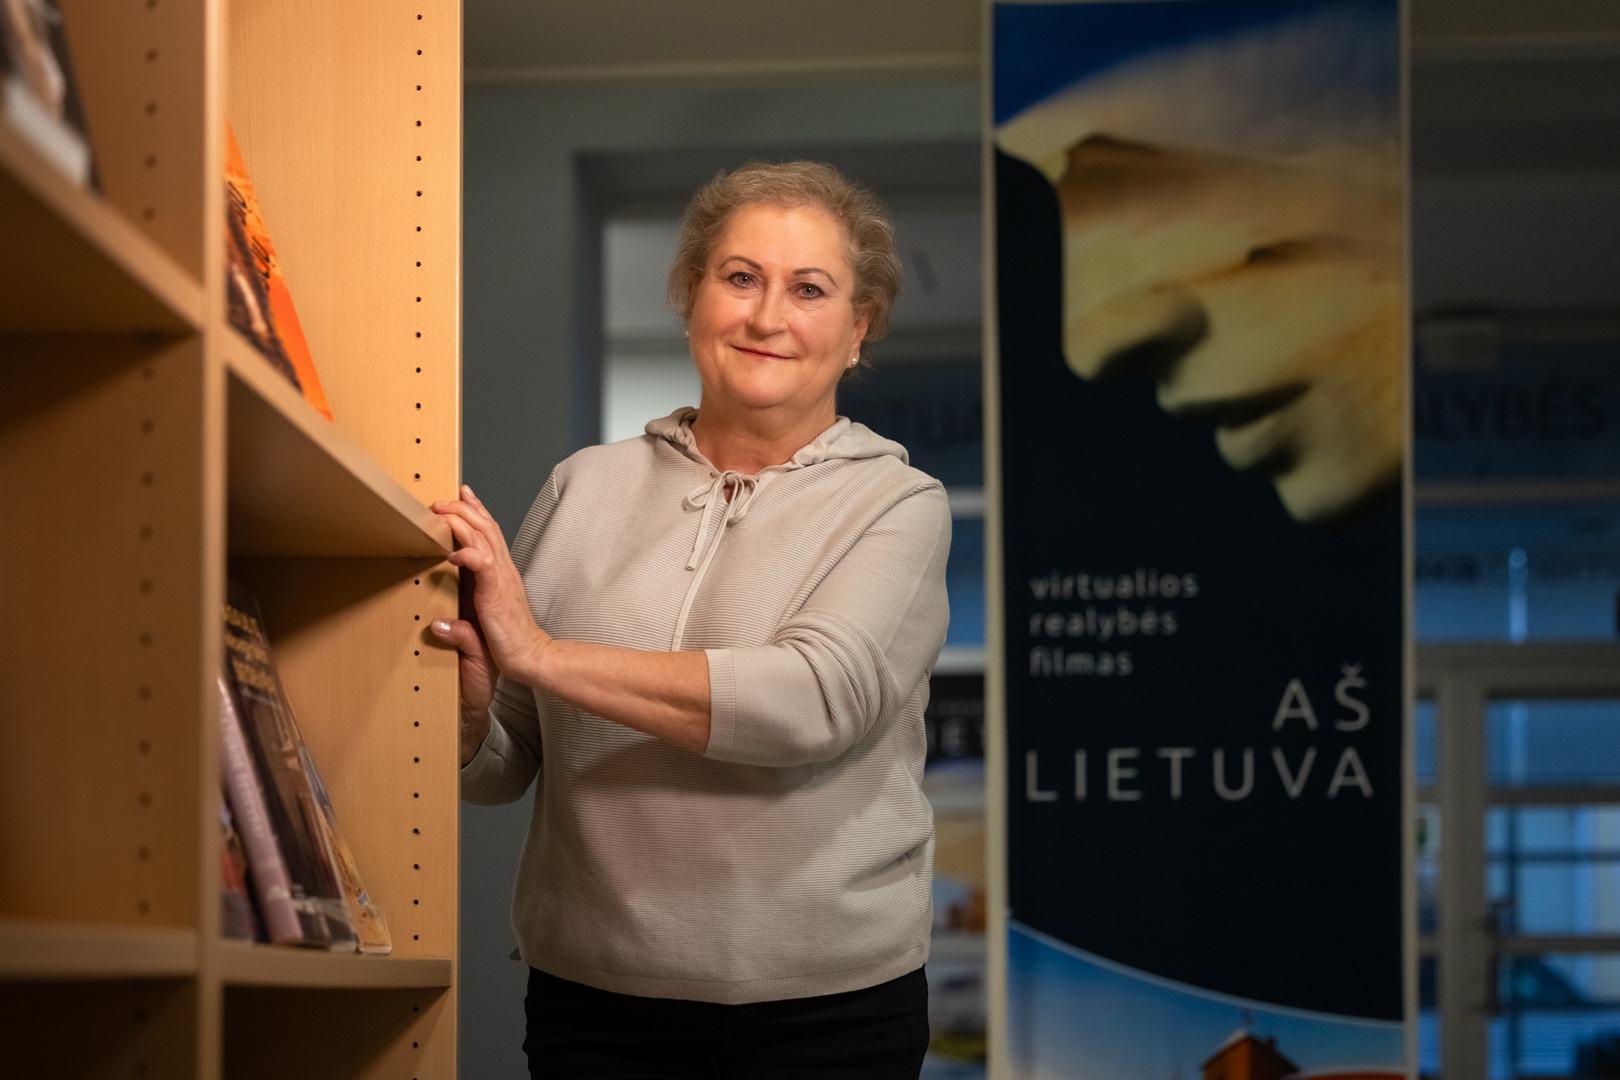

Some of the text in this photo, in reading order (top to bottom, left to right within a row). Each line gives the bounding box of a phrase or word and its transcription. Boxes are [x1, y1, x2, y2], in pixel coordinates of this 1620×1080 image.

[1029, 567, 1199, 600] virtualios
[1029, 604, 1179, 642] realybės
[1029, 645, 1134, 677] filmas
[1271, 662, 1371, 732] AŠ
[1025, 746, 1375, 802] LIETUVA
